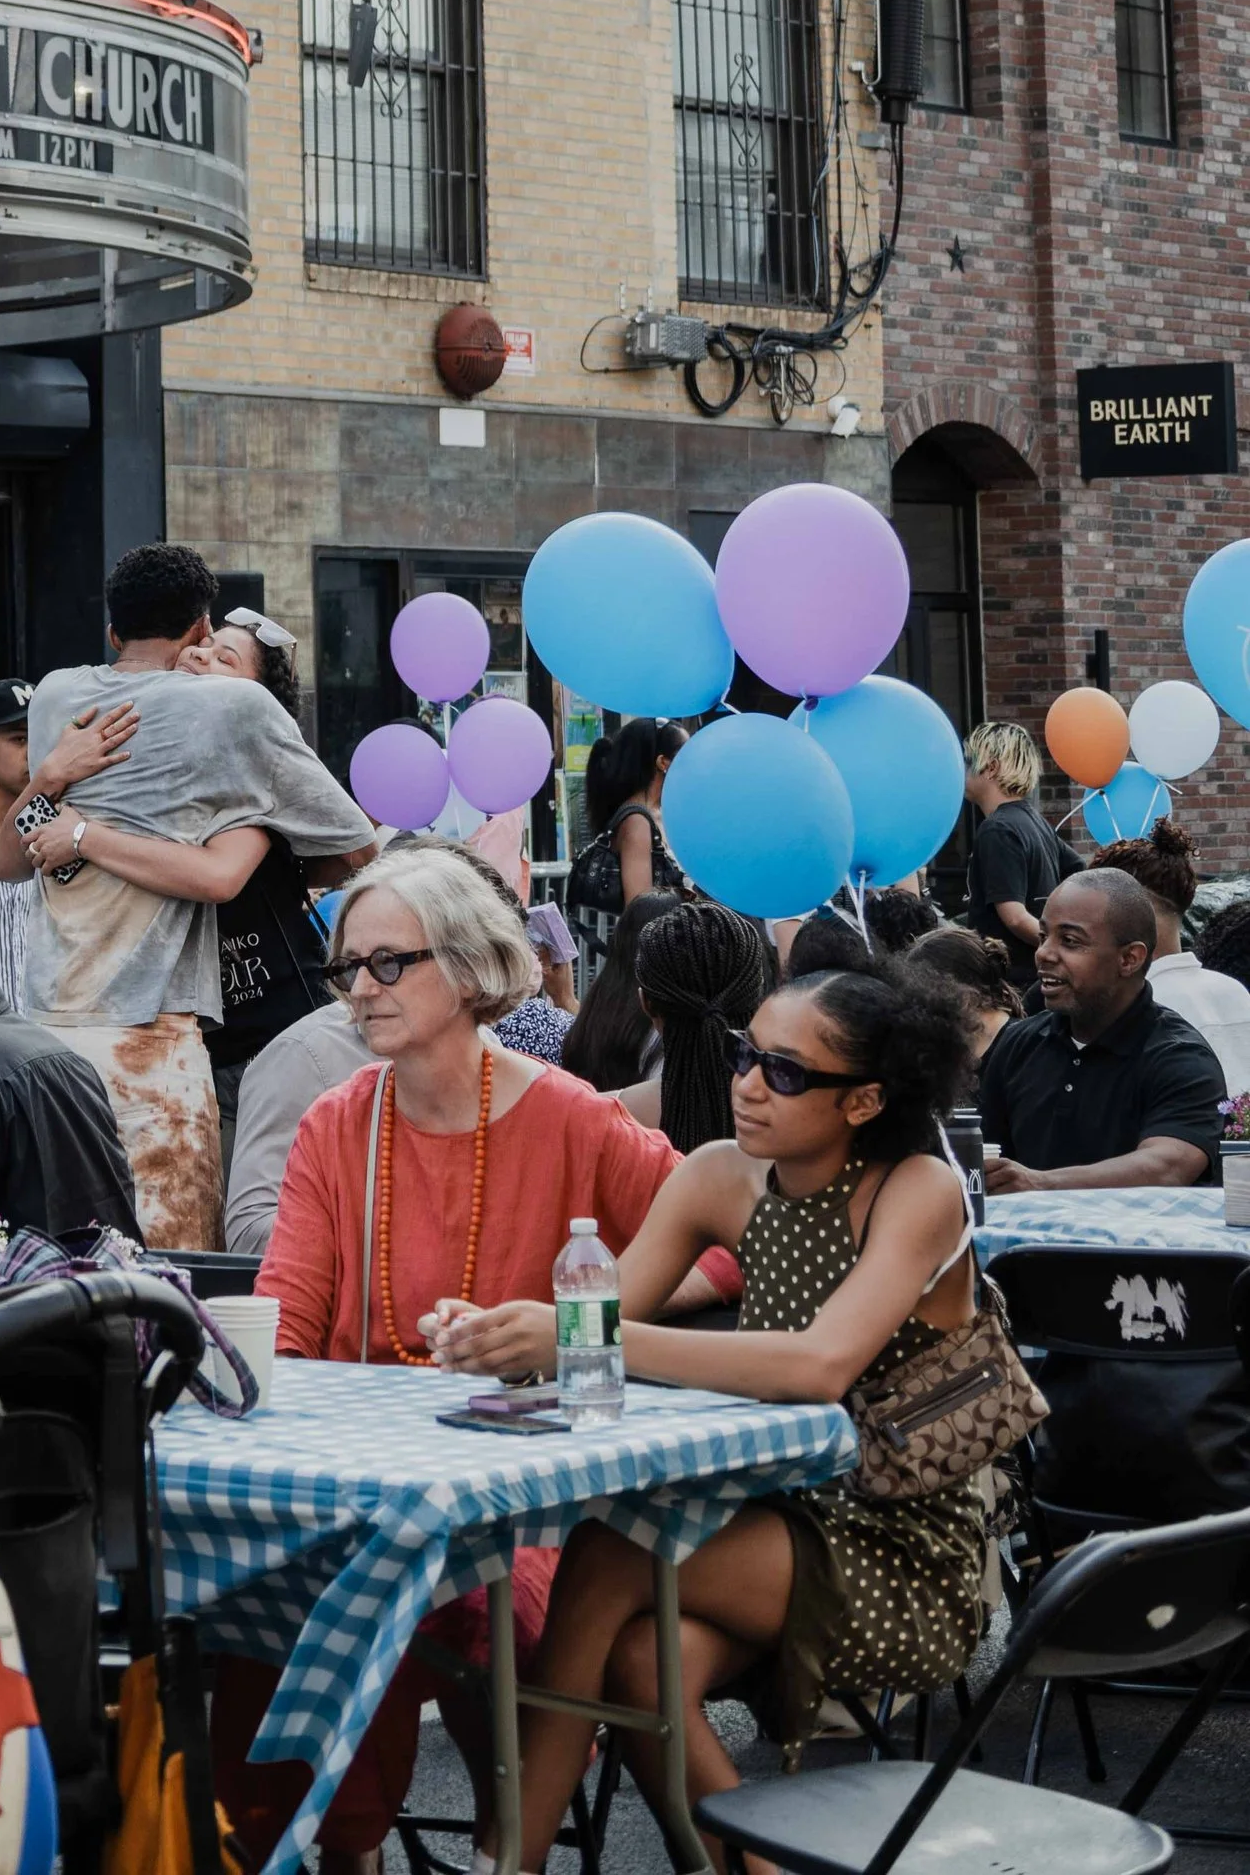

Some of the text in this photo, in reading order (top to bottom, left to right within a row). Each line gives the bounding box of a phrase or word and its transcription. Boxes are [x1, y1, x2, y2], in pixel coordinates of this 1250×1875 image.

[39, 36, 203, 145] CHURCH
[39, 132, 96, 170] 12PM
[1090, 395, 1212, 422] BRILLIANT
[1114, 421, 1190, 445] EARTH
[220, 932, 260, 954] AIKO
[221, 956, 271, 993] OUR
[231, 986, 264, 1006] 2024
